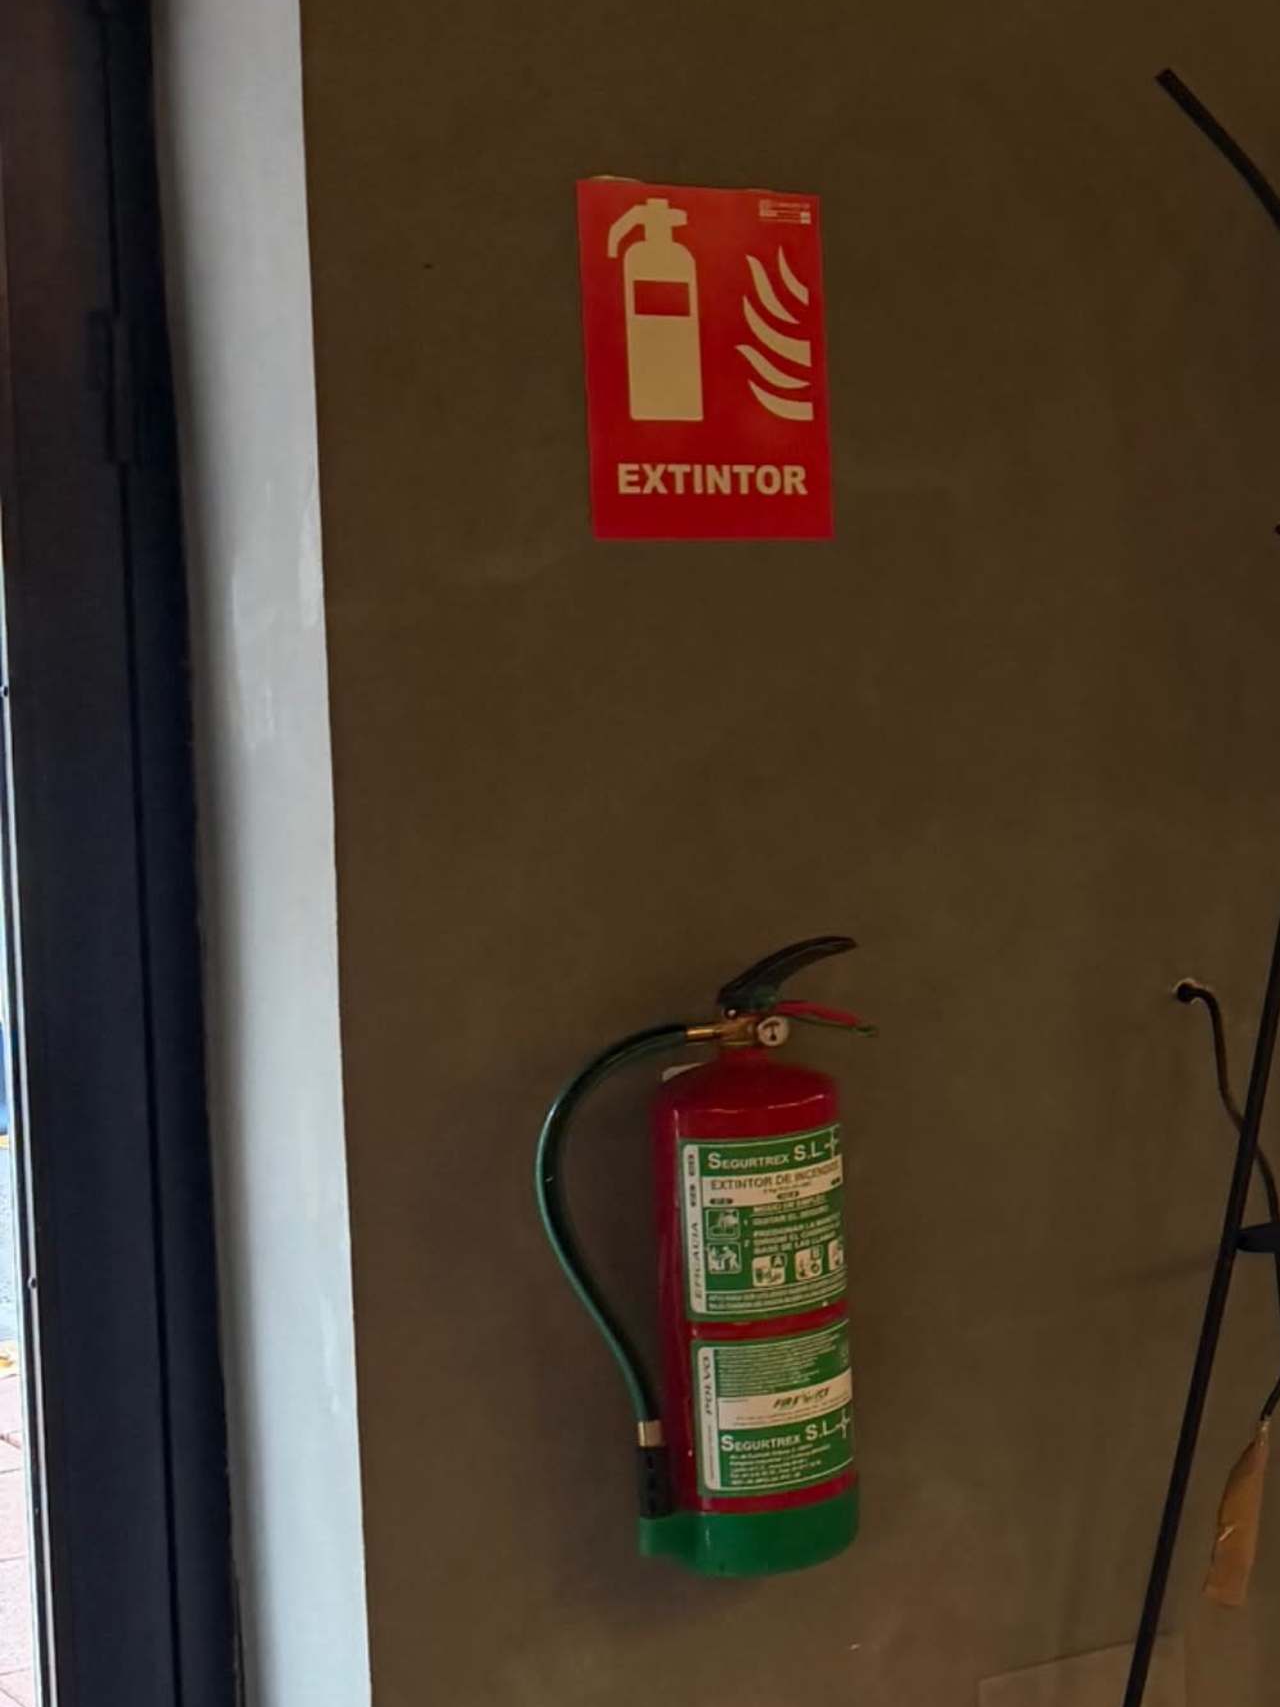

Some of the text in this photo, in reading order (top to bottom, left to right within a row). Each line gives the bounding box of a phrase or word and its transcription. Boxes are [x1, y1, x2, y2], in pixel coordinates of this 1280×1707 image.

[617, 463, 808, 495] EXTINTOR
[707, 1152, 790, 1170] SEGURTREX
[710, 1176, 773, 1191] EXTINTOR
[776, 1172, 790, 1185] DE
[720, 1434, 801, 1453] SEGURTREX
